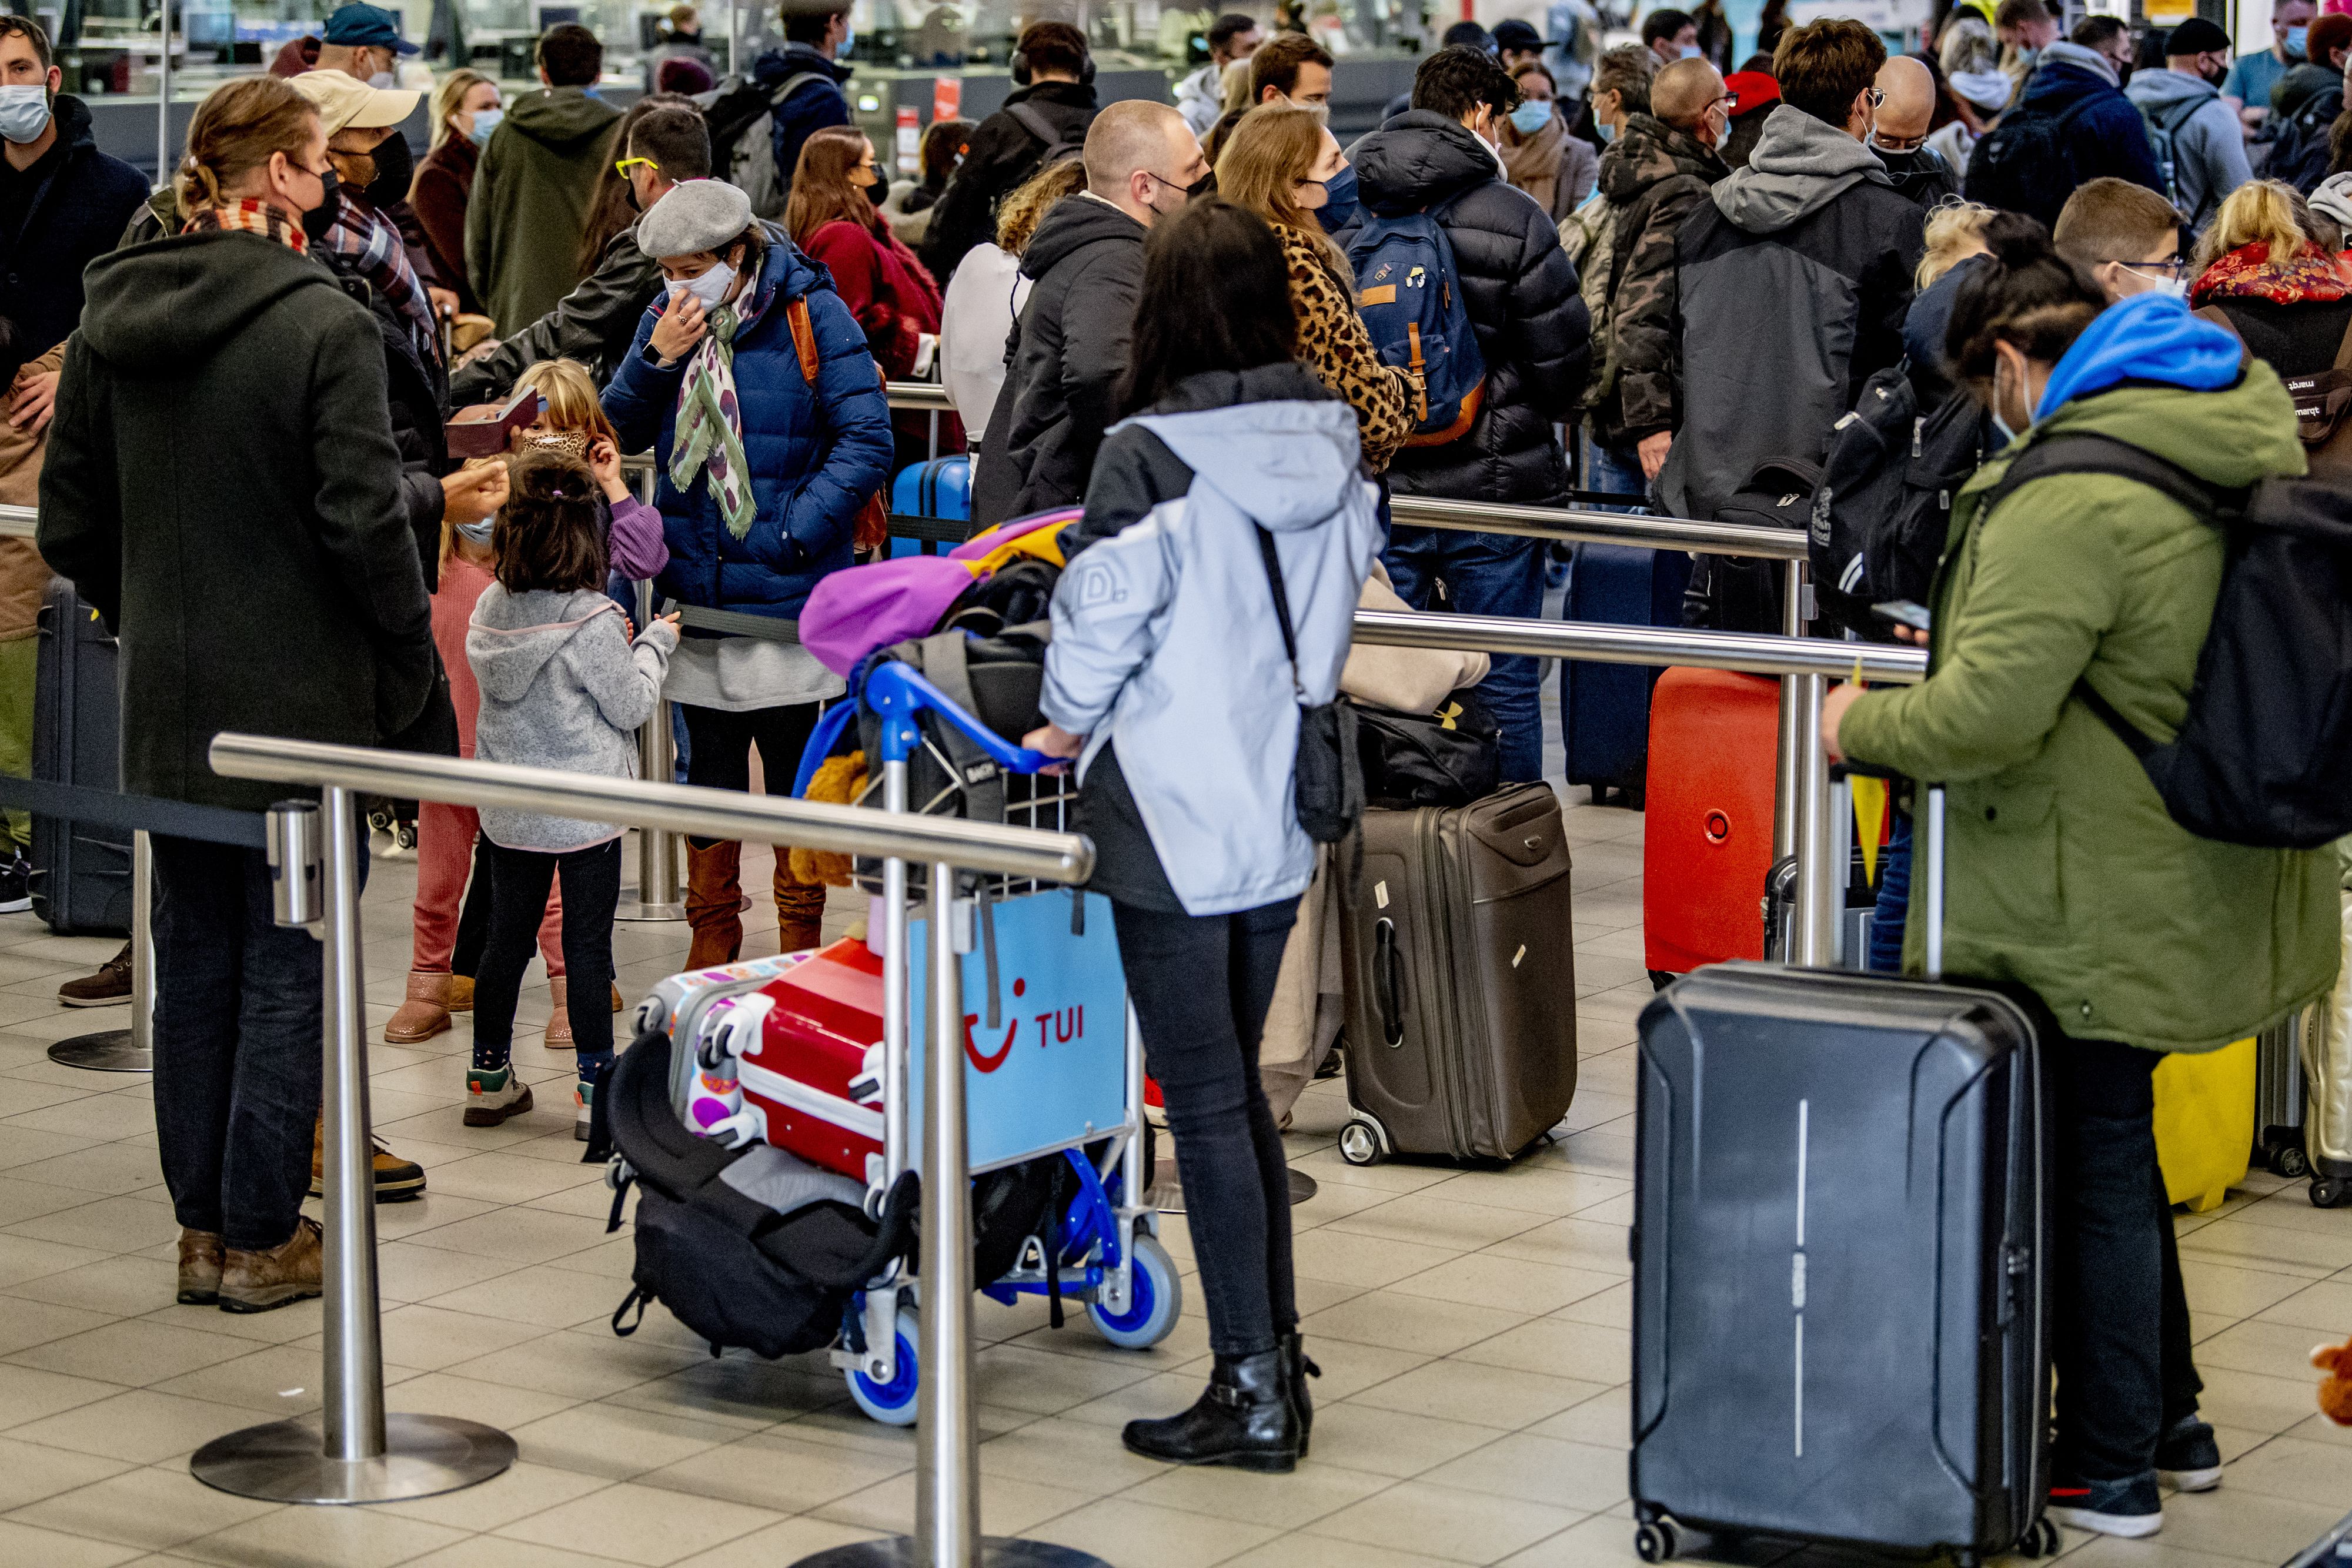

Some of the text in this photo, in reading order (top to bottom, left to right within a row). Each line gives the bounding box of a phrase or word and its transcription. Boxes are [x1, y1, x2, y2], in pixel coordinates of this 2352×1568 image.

[2288, 380, 2314, 391] marqt
[2294, 406, 2320, 416] marqt
[1034, 1004, 1083, 1048] TUI
